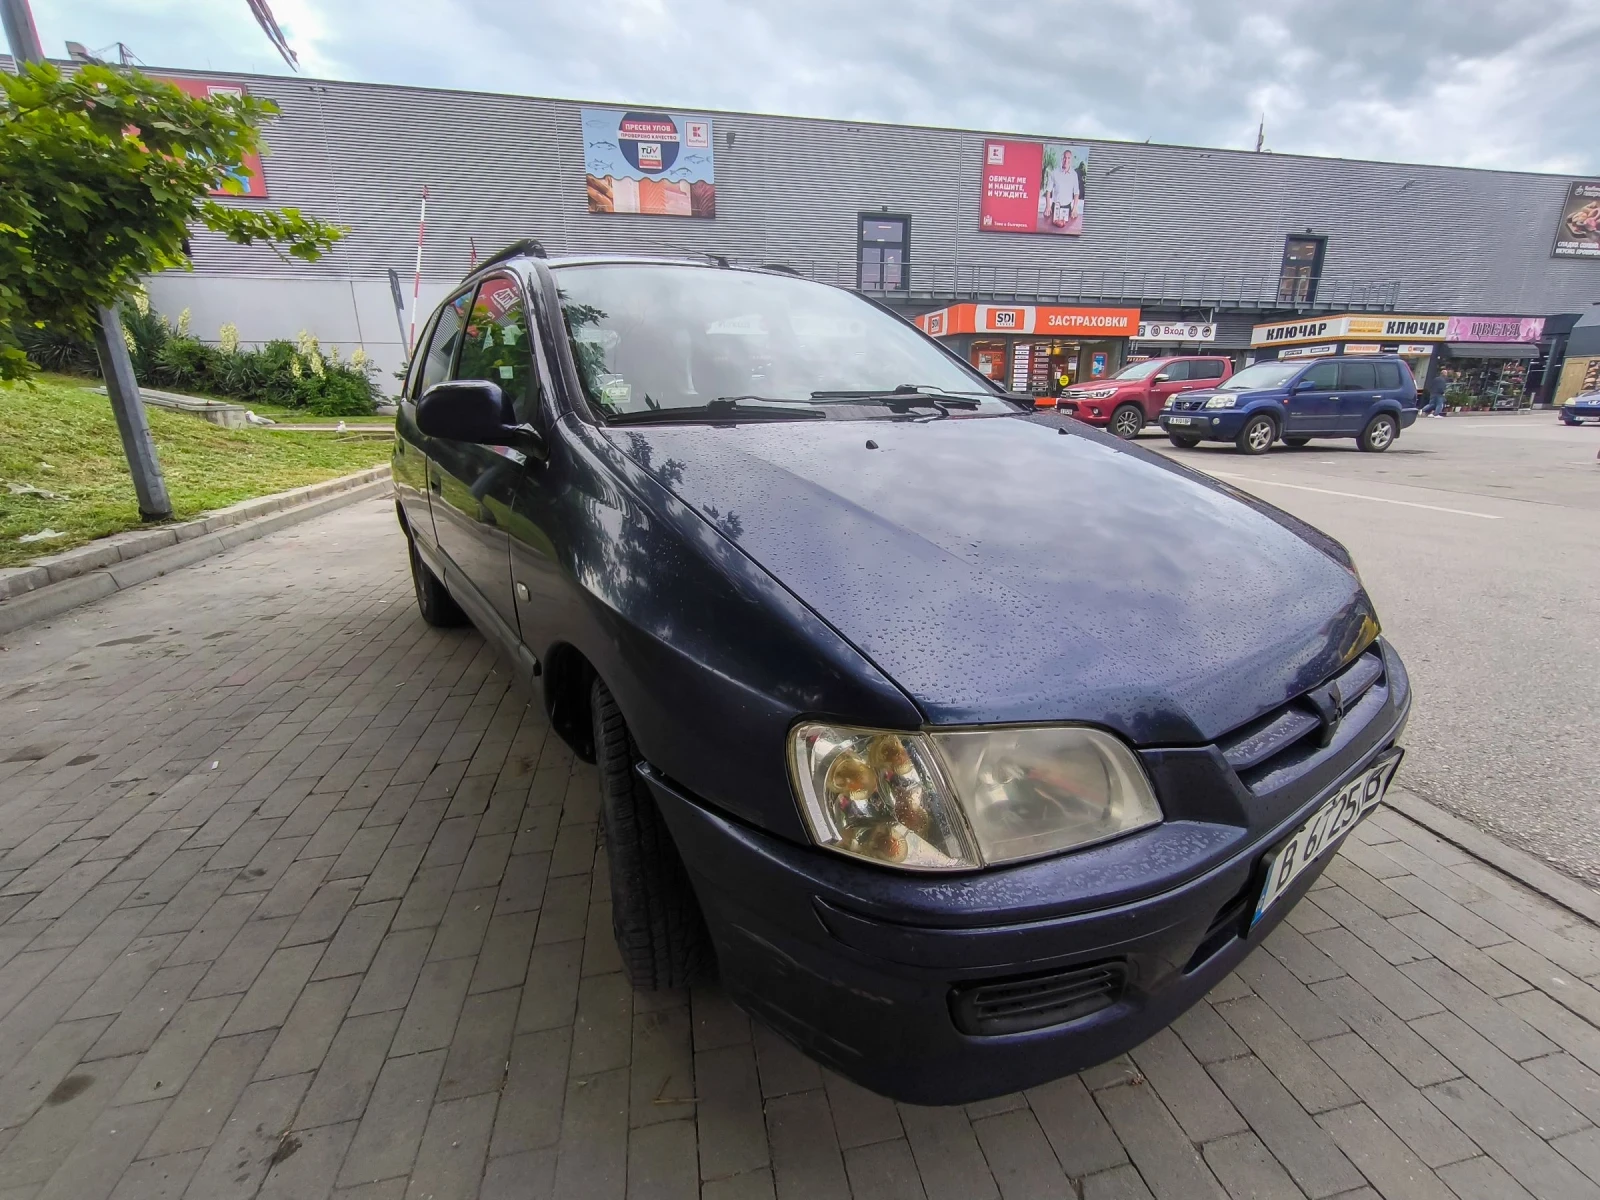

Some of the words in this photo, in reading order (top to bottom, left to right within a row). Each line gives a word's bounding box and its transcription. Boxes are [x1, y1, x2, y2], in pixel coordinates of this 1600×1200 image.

[988, 175, 1015, 183] ОБИЧАТ
[1016, 176, 1026, 184] МЕ
[994, 184, 1024, 192] НАШИТЕ,
[994, 191, 1028, 199] ЧУЖДИТЕ.
[997, 313, 1015, 323] SDI
[1048, 315, 1128, 327] ЗАСТРАХОВКИ
[1164, 326, 1185, 336] Вход
[1266, 322, 1327, 341] КЛЮЧАР
[1386, 321, 1446, 335] КЛЮЧАР
[1470, 322, 1521, 340] ЦВЕТЯ
